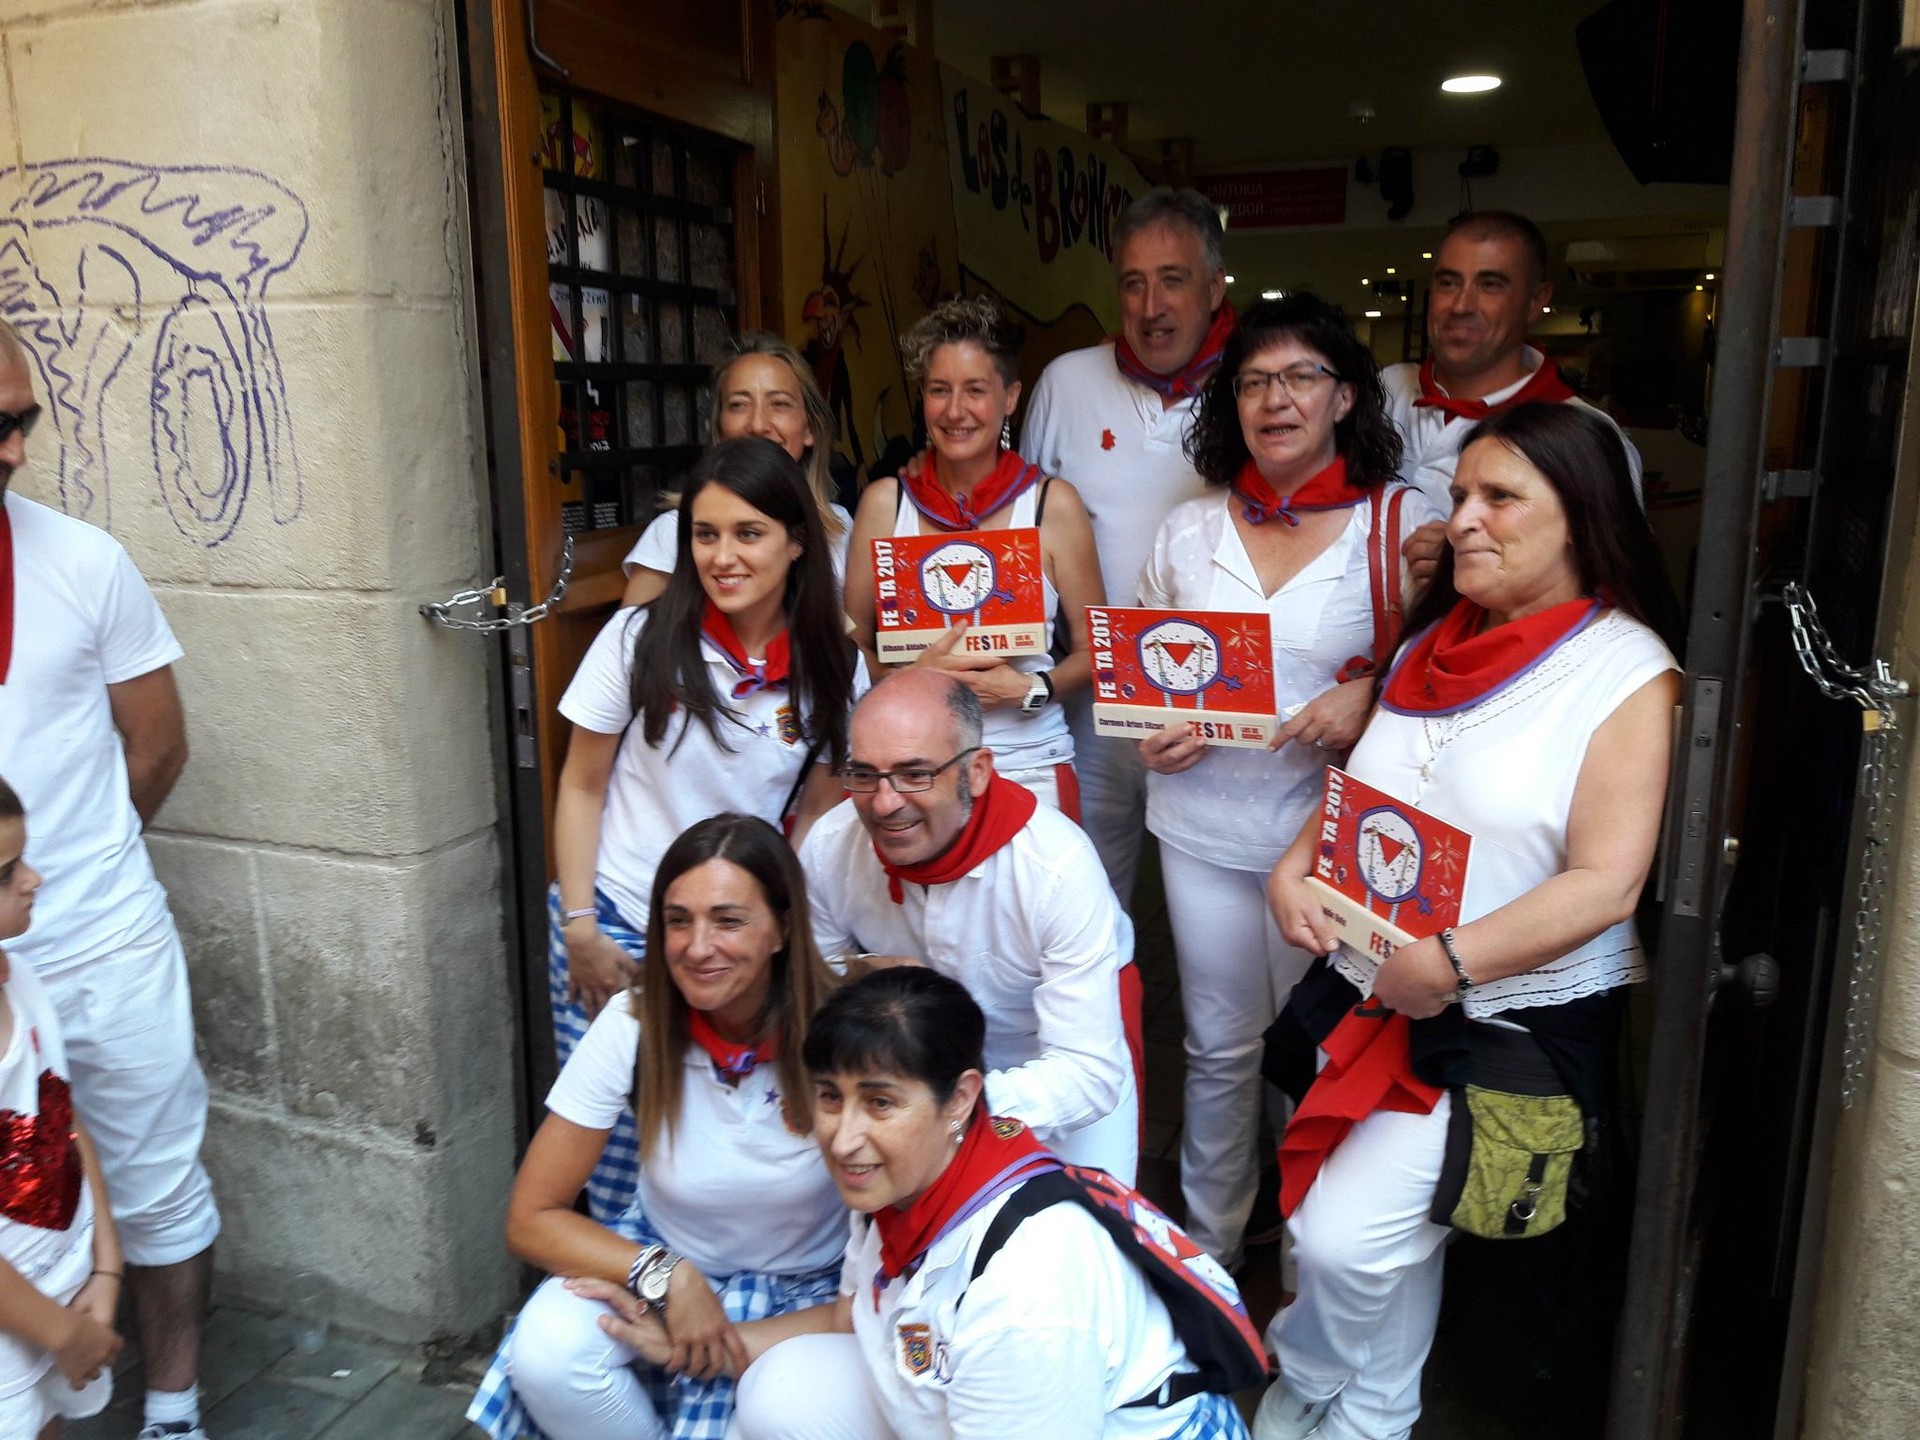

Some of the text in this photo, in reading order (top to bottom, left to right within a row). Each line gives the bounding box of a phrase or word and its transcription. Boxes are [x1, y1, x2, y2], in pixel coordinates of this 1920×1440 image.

[1034, 146, 1134, 265] BRONC
[874, 540, 896, 578] 2017
[965, 634, 1009, 652] FESTA
[1090, 609, 1111, 647] 2017
[1325, 771, 1345, 819] 2017
